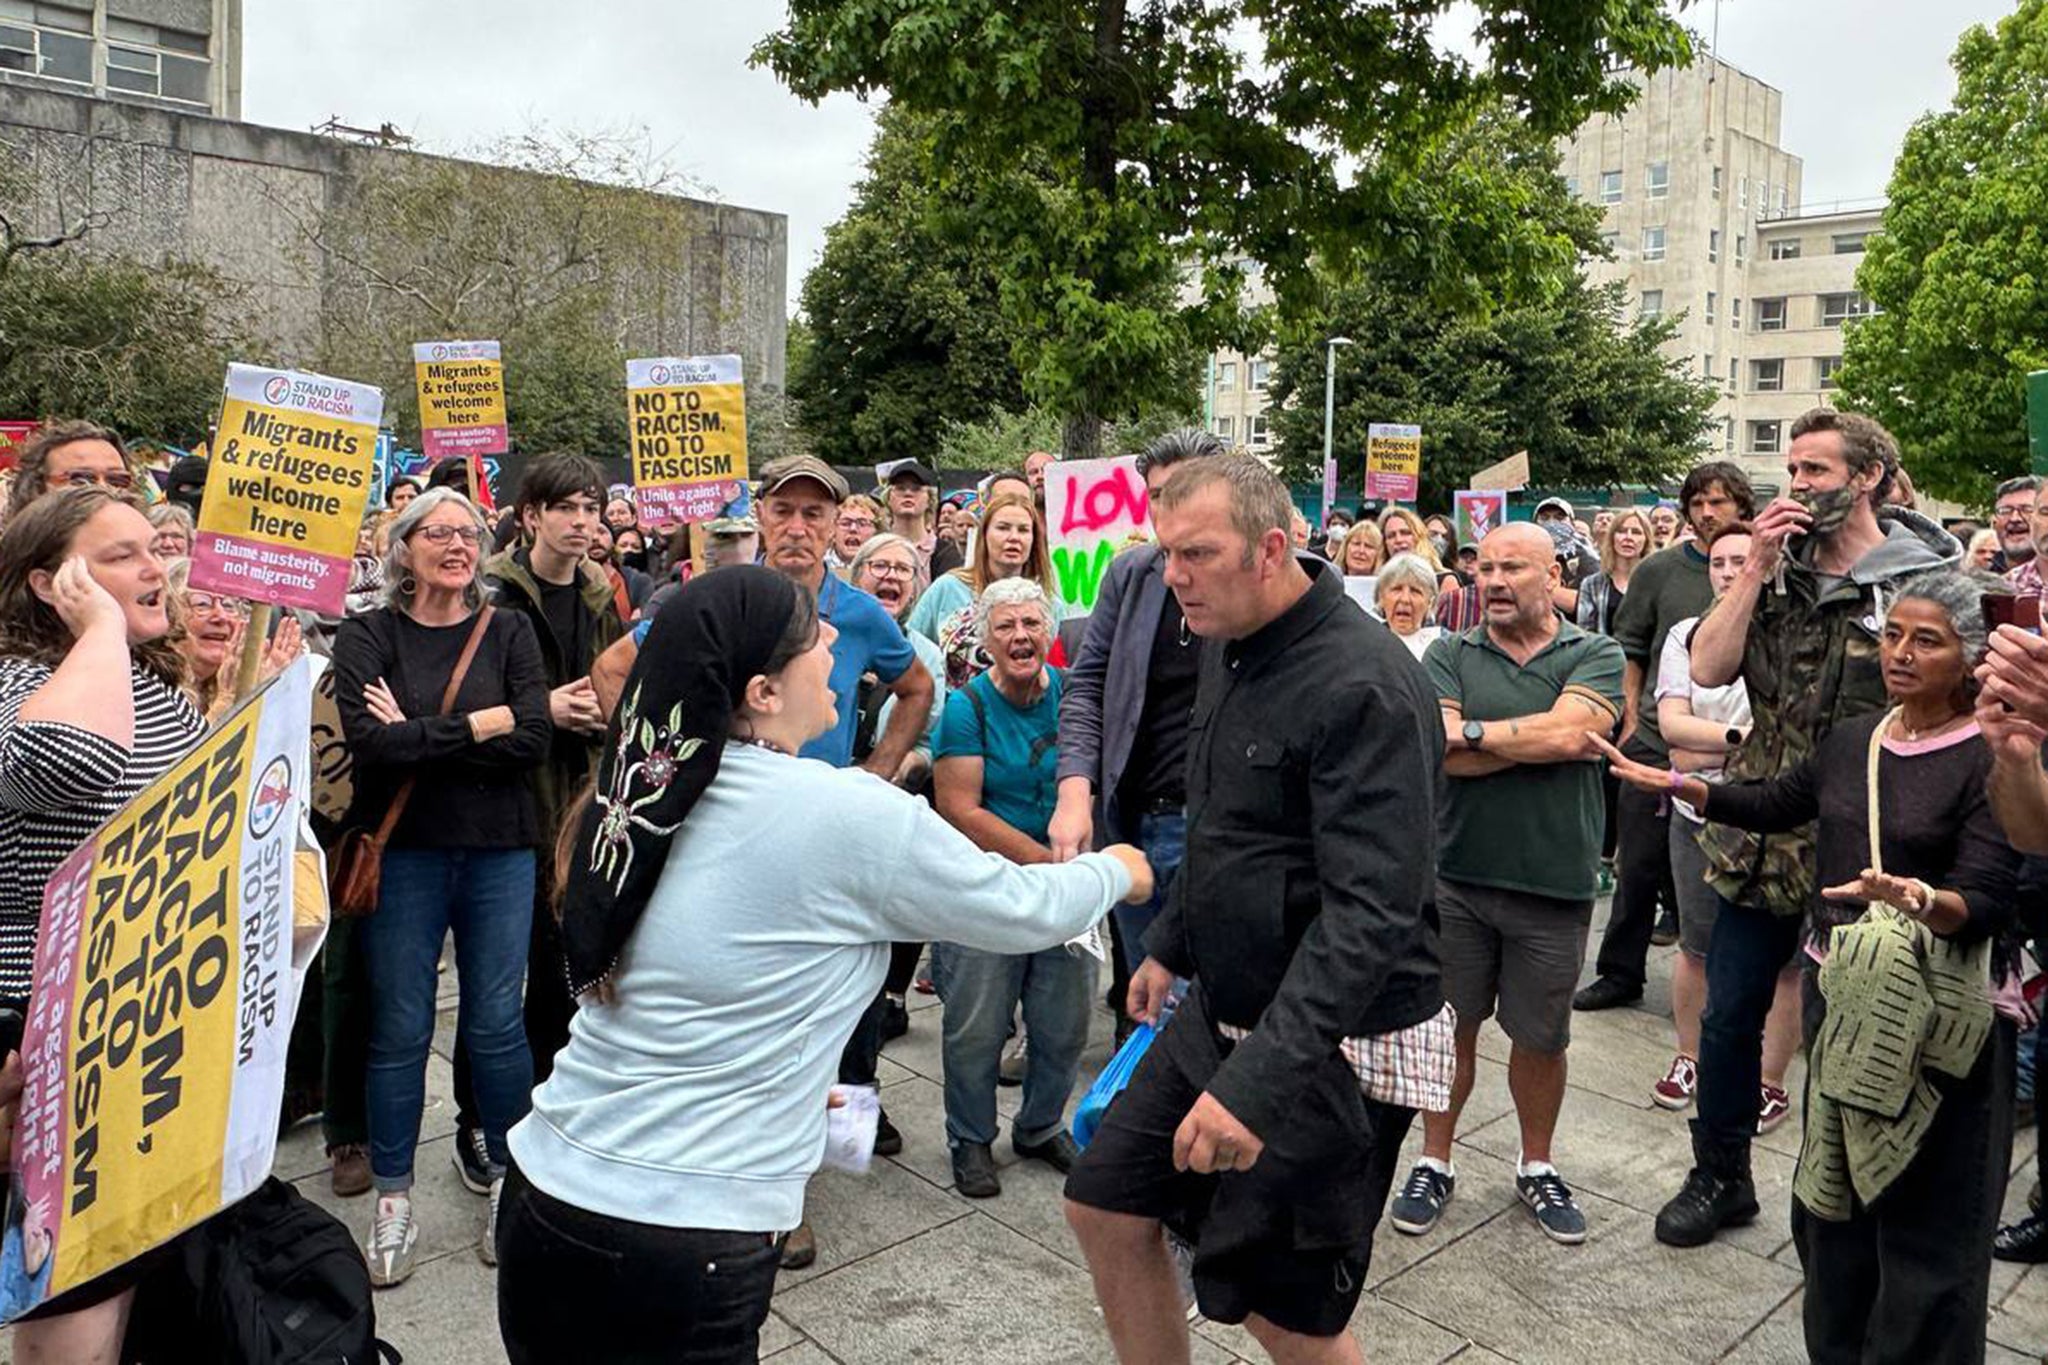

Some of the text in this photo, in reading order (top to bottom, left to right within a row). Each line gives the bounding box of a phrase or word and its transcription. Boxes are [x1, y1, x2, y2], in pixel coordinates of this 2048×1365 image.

[428, 364, 492, 380] Migrants
[672, 375, 683, 384] TO
[292, 381, 350, 401] STAND UP
[423, 380, 499, 395] & refugees
[292, 394, 353, 416] TO RACISM
[431, 396, 493, 409] welcome
[635, 391, 700, 414] NO TO
[448, 411, 480, 424] here
[637, 412, 726, 436] RACISM,
[242, 410, 358, 455] Migrants
[638, 435, 704, 458] NO TO
[1372, 438, 1417, 452] Refugees
[1372, 450, 1415, 461] welcome
[222, 438, 363, 488] & refugees
[640, 455, 732, 480] FASCISM
[1381, 461, 1403, 471] here
[228, 477, 340, 515] welcome
[642, 484, 721, 503] Unite against
[1061, 467, 1148, 535] LOV
[644, 505, 664, 518] the
[688, 501, 715, 517] right
[250, 506, 307, 541] here
[214, 538, 259, 561] Blame
[223, 561, 316, 590] not migrants
[187, 724, 249, 1009] NO TO
[107, 791, 172, 1069] NO TO
[259, 837, 281, 1029] STAND UP
[137, 758, 210, 1154] RACISM,
[238, 850, 262, 1067] TO RACISM
[42, 859, 93, 1180] Unite against
[71, 822, 136, 1218] FASCISM
[21, 1046, 45, 1163] right
